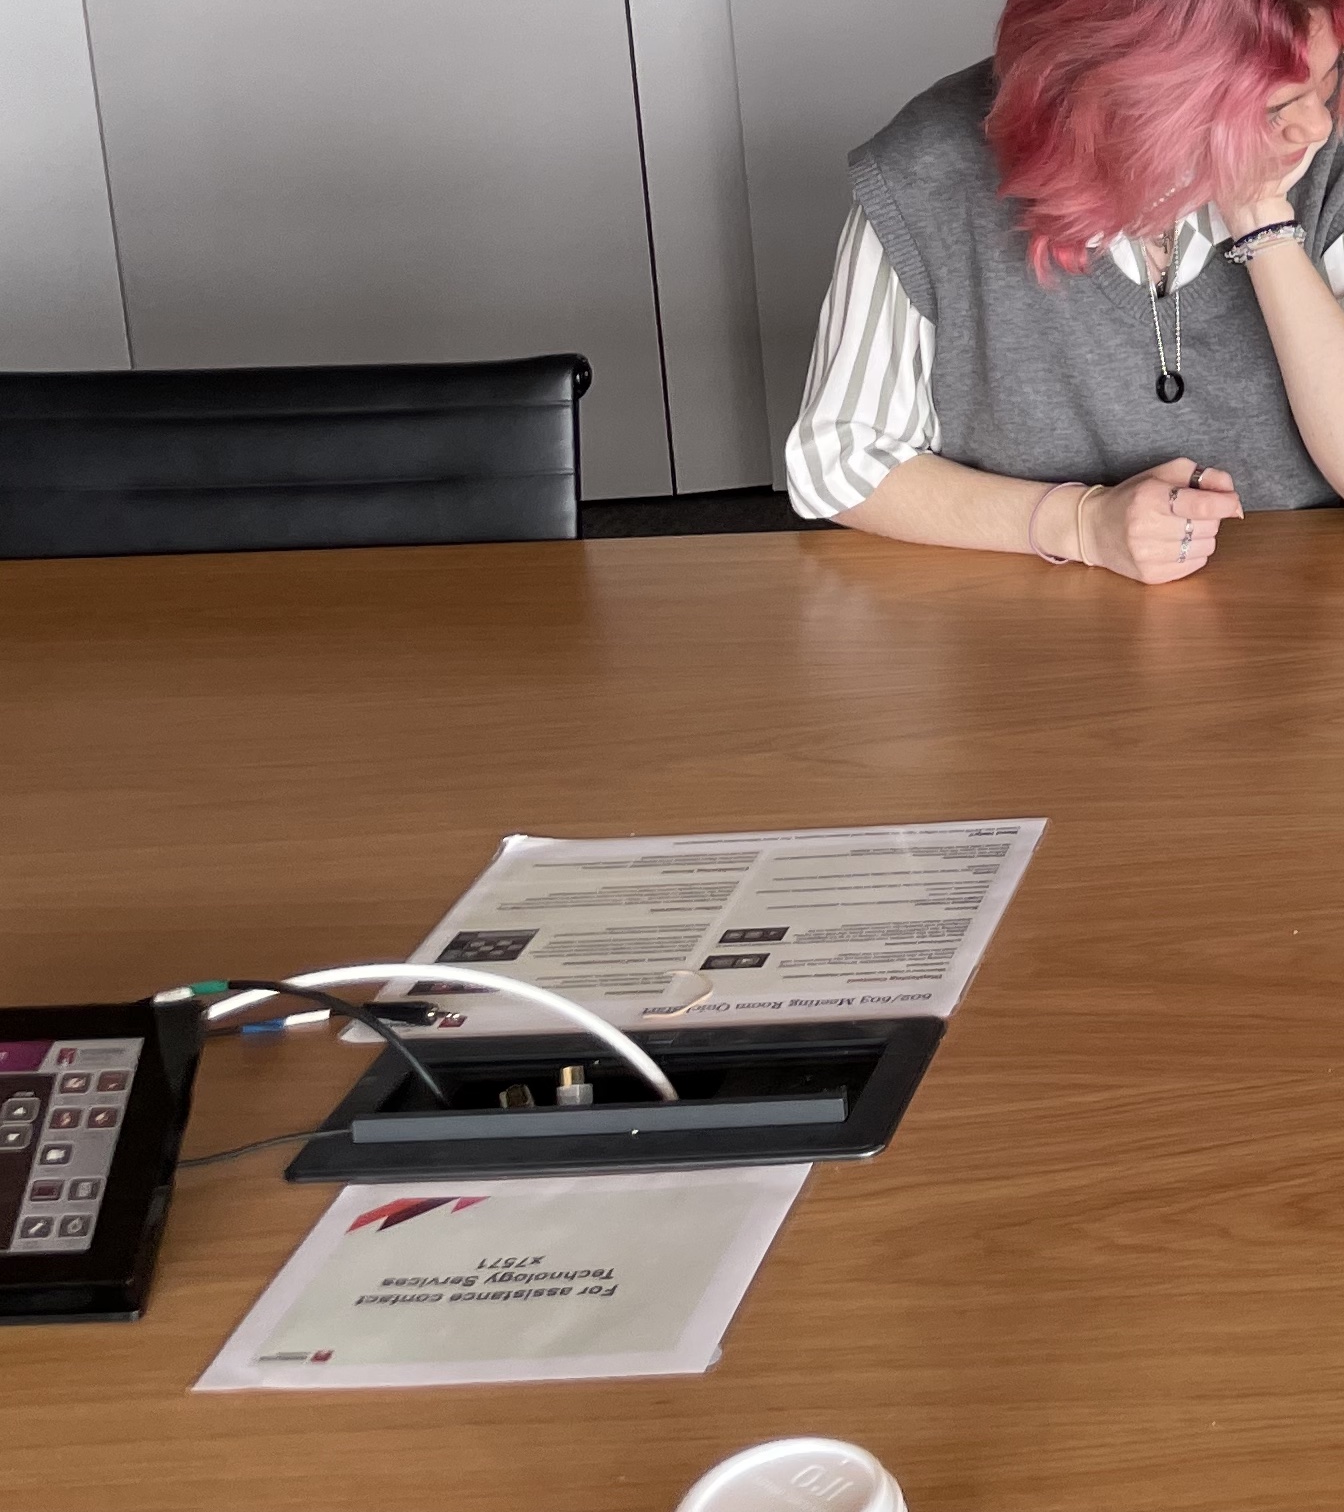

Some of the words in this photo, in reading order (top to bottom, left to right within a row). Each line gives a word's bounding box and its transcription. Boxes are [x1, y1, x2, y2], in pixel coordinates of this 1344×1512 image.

[735, 1000, 783, 1011] Room
[789, 996, 855, 1008] Meeting
[859, 992, 933, 1005] 602/603
[476, 1255, 546, 1270] x7571
[381, 1275, 479, 1287] Services
[484, 1267, 615, 1285] Technology
[449, 1286, 574, 1302] assistance
[575, 1283, 619, 1297] For
[354, 1291, 444, 1306] contact
